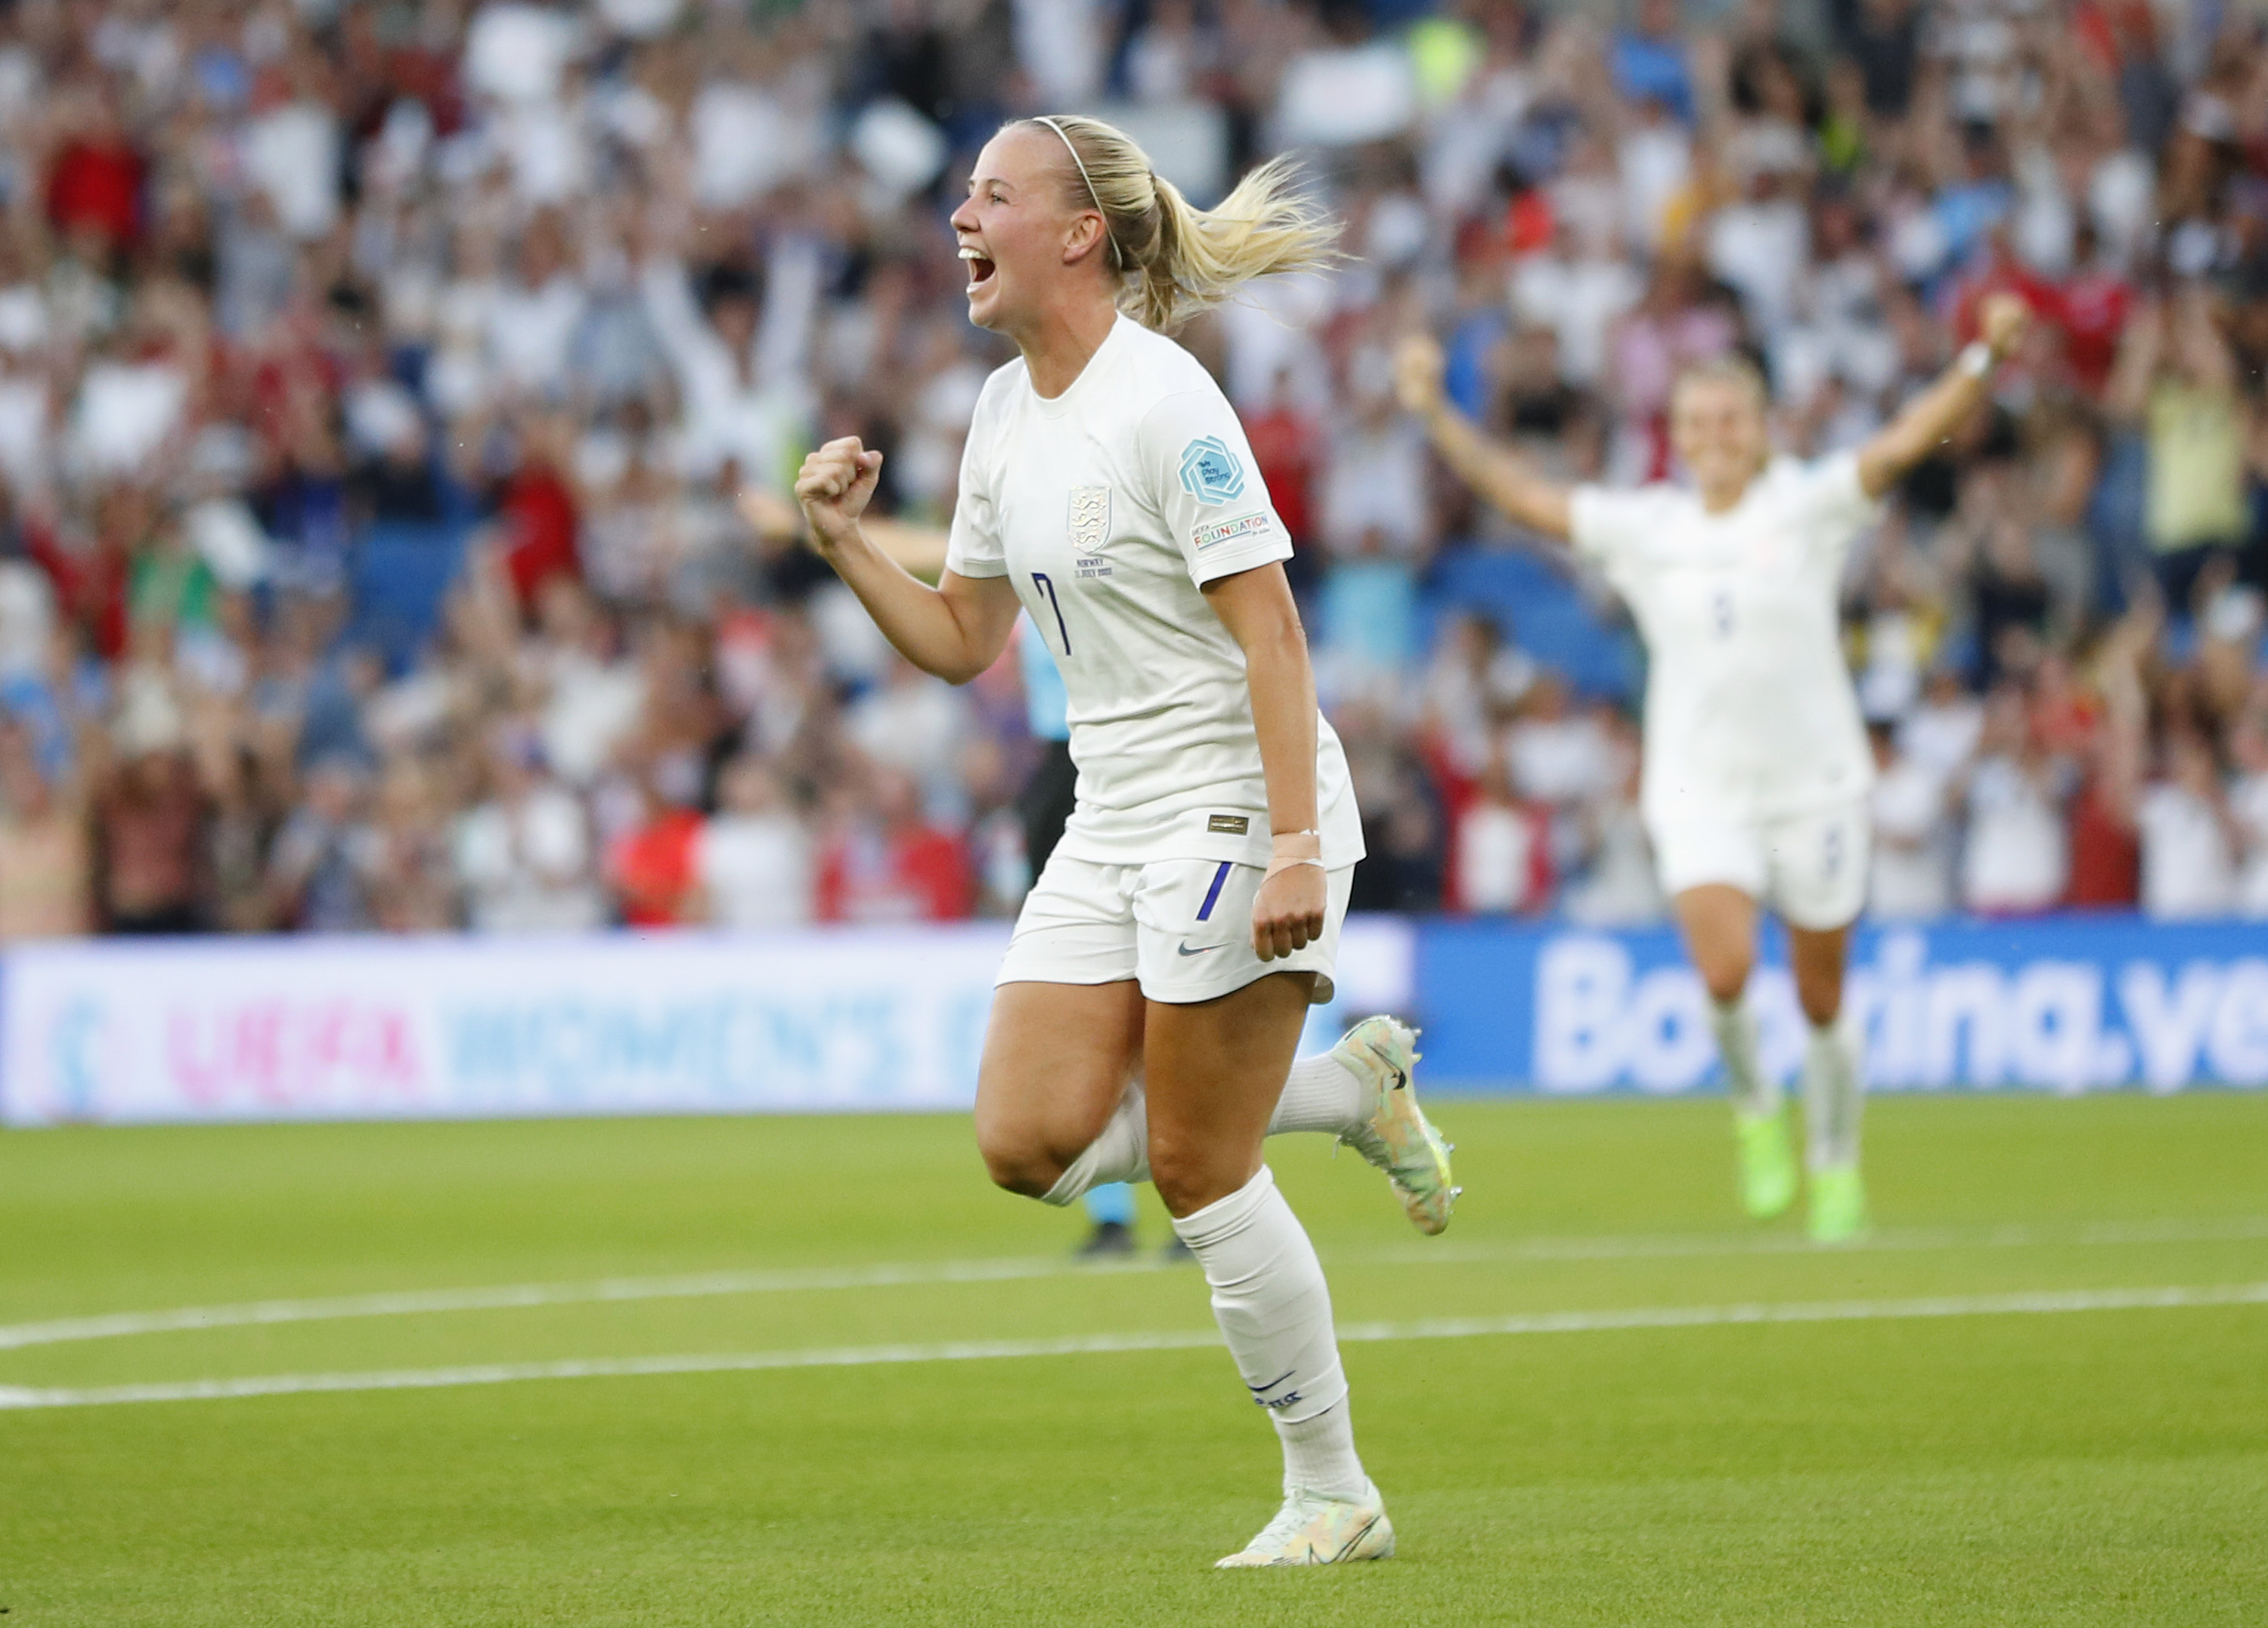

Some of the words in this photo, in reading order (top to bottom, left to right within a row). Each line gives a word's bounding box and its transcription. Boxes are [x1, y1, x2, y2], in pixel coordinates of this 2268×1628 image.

[1194, 515, 1269, 547] FOUNDATION
[1030, 572, 1071, 656] 7
[166, 1001, 423, 1105] UEFA
